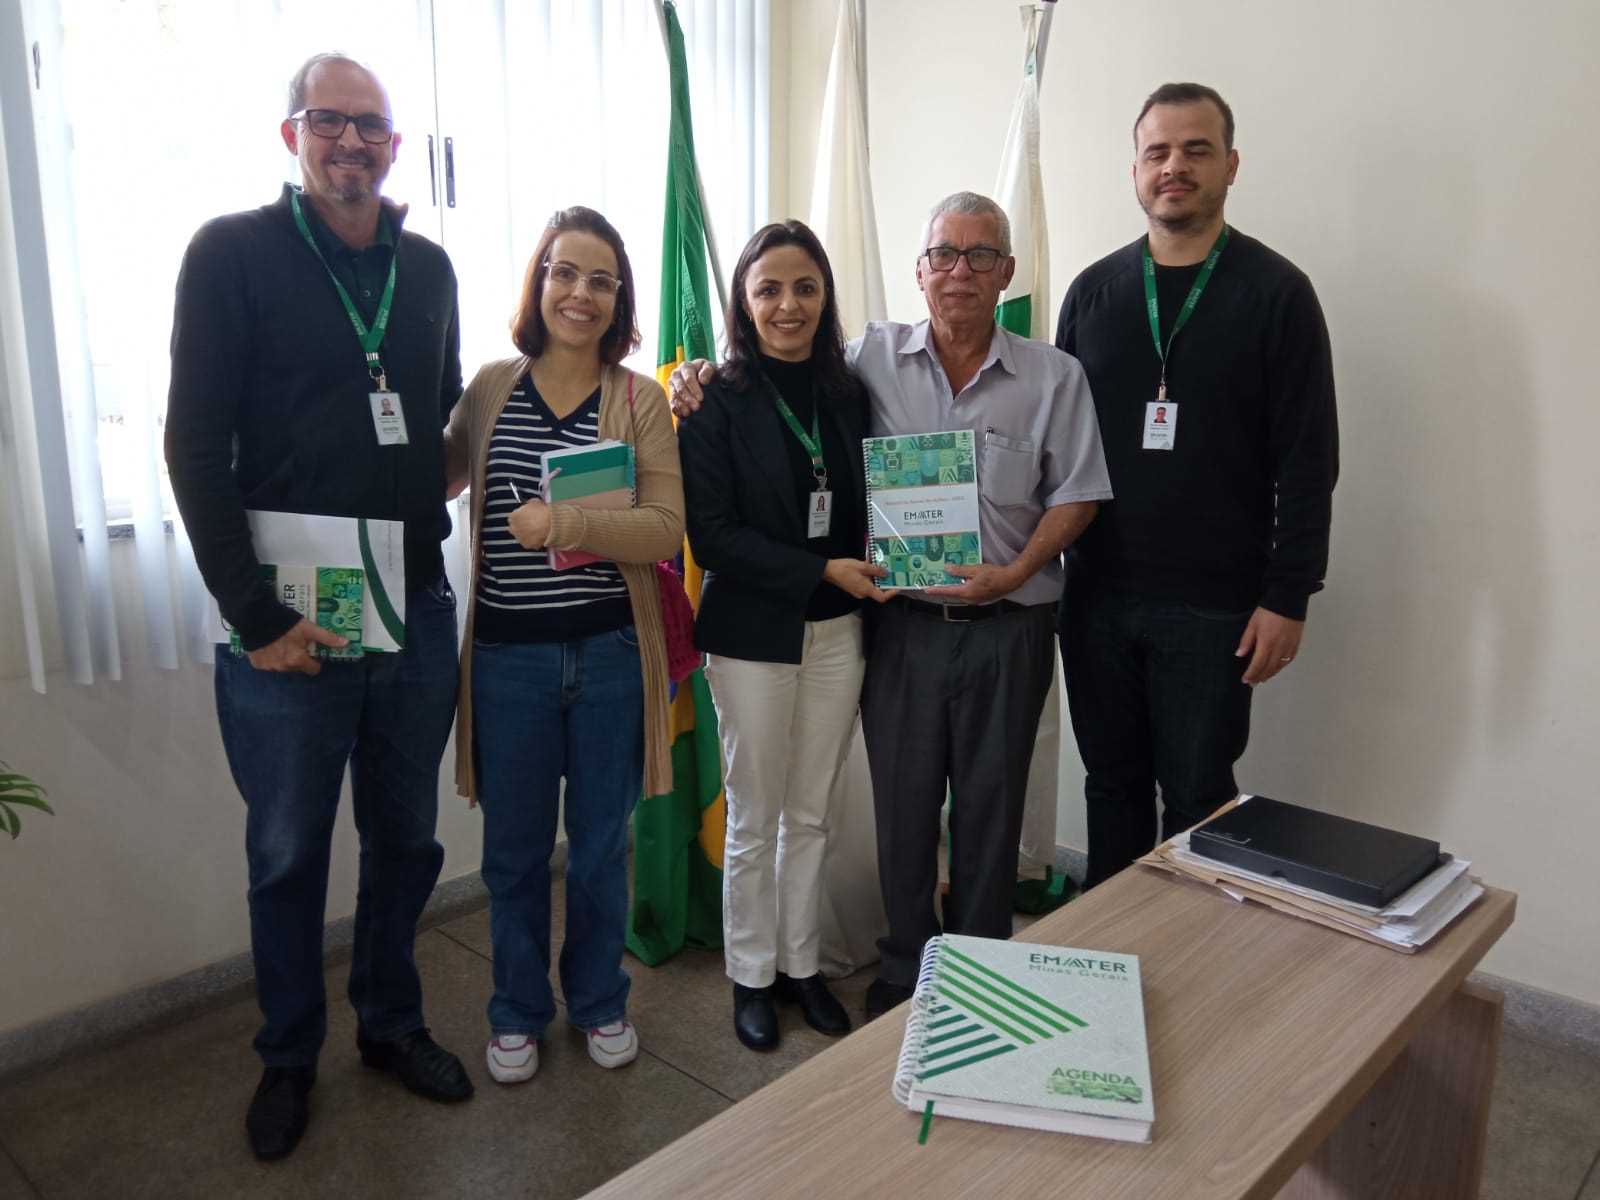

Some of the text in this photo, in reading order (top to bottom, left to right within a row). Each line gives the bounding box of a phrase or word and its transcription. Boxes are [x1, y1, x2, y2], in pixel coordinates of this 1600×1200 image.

[1028, 963, 1129, 982] Minas Gerais
[1029, 953, 1127, 973] EMATER
[1052, 1067, 1136, 1086] AGENDA
